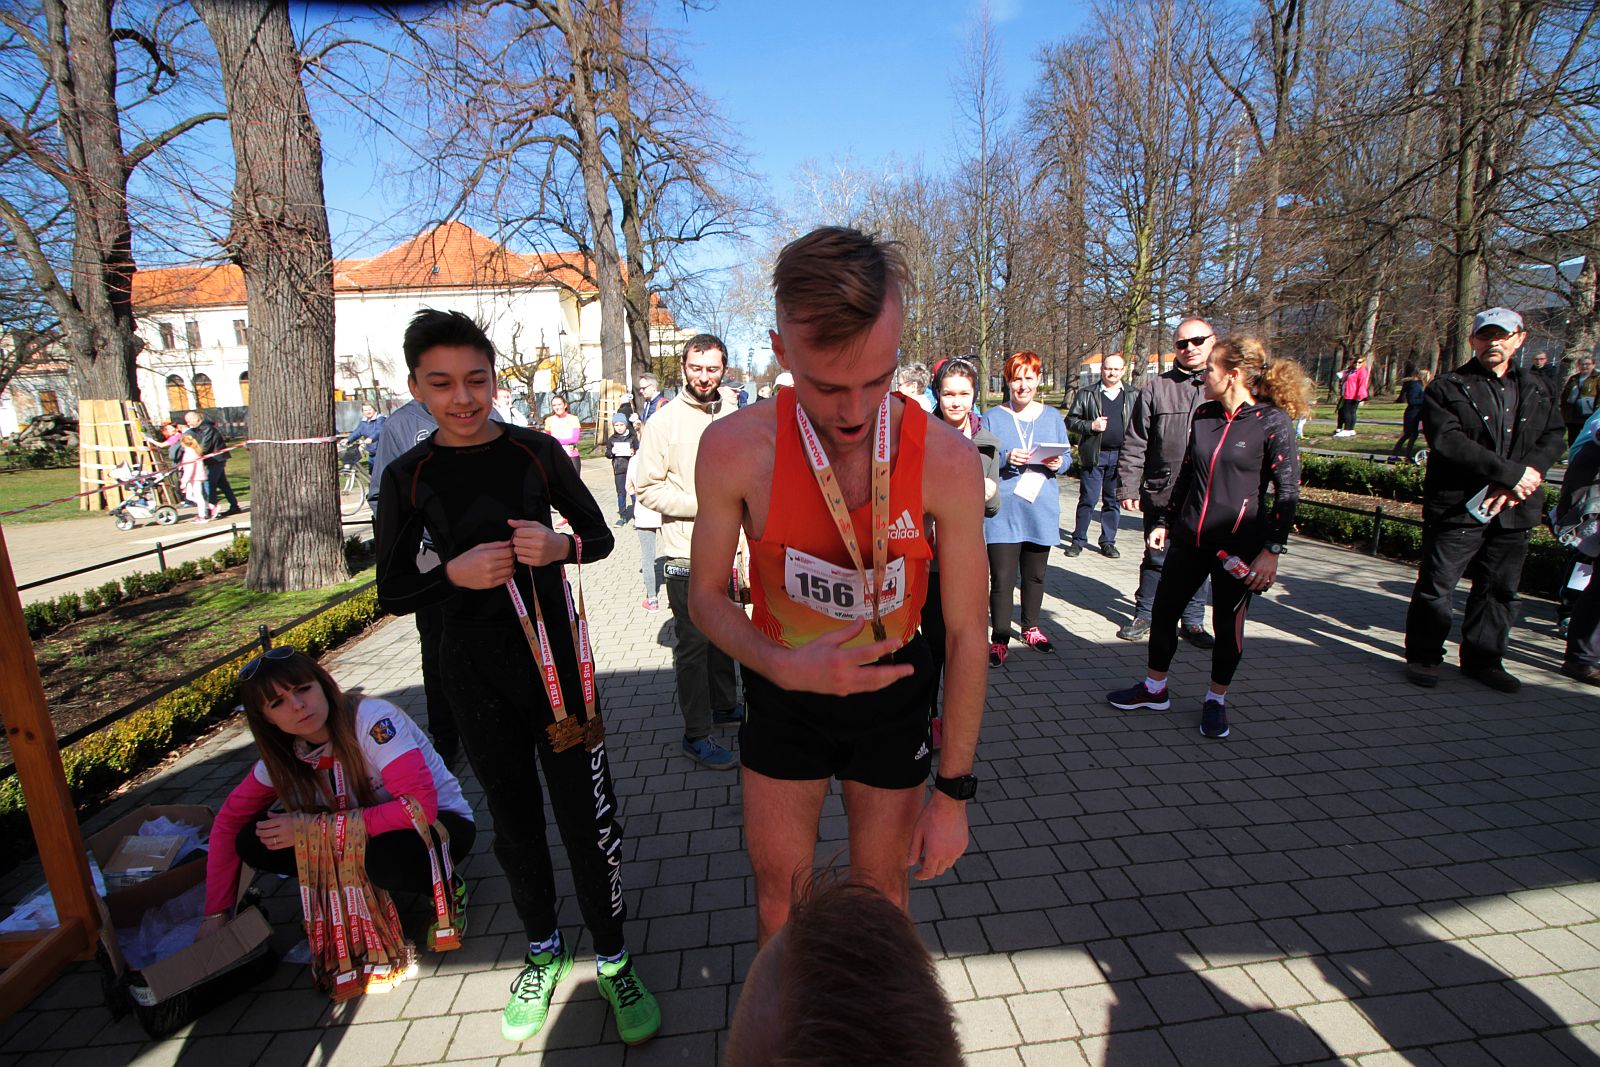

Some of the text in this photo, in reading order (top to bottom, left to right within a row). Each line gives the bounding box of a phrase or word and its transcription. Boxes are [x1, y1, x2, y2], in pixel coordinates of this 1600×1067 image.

[795, 572, 854, 608] 156
[547, 666, 556, 682] Stu
[549, 682, 561, 706] BIEG
